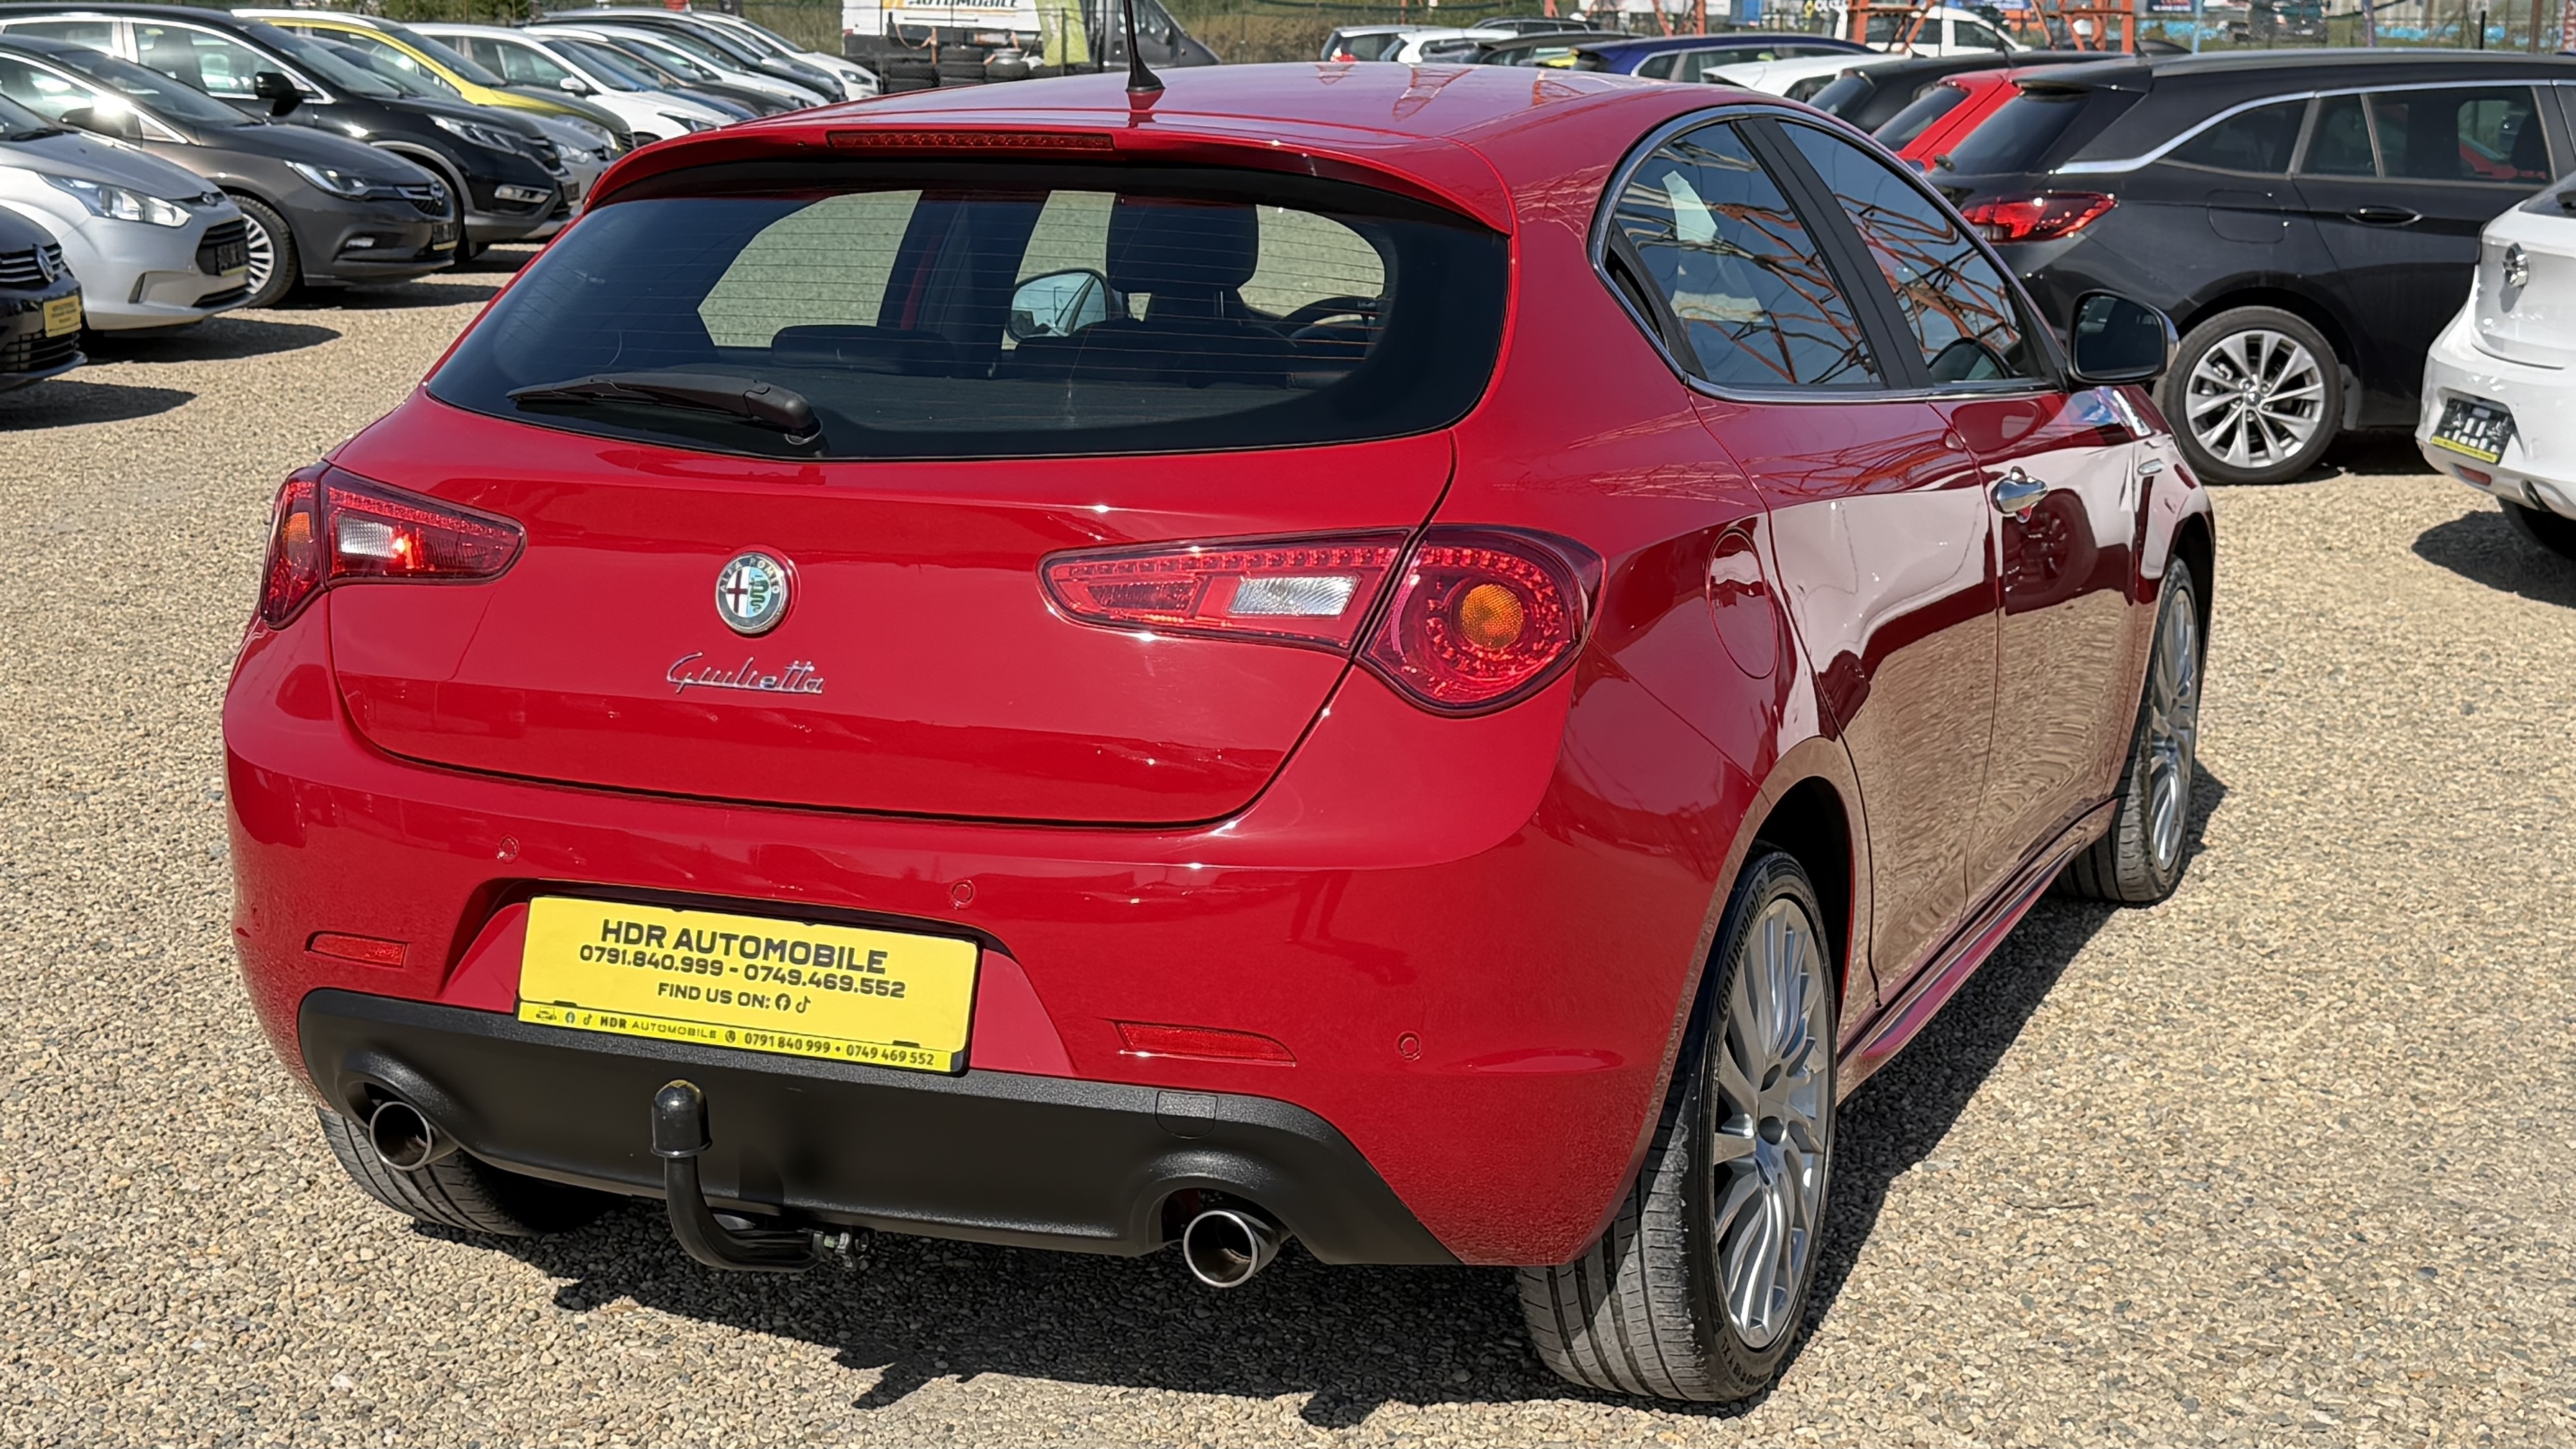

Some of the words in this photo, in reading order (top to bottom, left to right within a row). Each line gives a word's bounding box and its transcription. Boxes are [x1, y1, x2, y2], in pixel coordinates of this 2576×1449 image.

[719, 561, 743, 593] ALFA
[749, 557, 781, 594] ROMEO
[666, 651, 824, 694] Giulietta
[601, 919, 667, 948] HDR
[672, 928, 888, 975] AUTOMOBILE
[580, 944, 724, 976] 0791.840.999
[744, 964, 906, 998] 0749.469.552
[658, 982, 701, 1000] FIND
[705, 987, 732, 1004] US
[737, 992, 771, 1009] ON:
[600, 1016, 627, 1029] HDR
[631, 1021, 718, 1039] AUTOMOBILE
